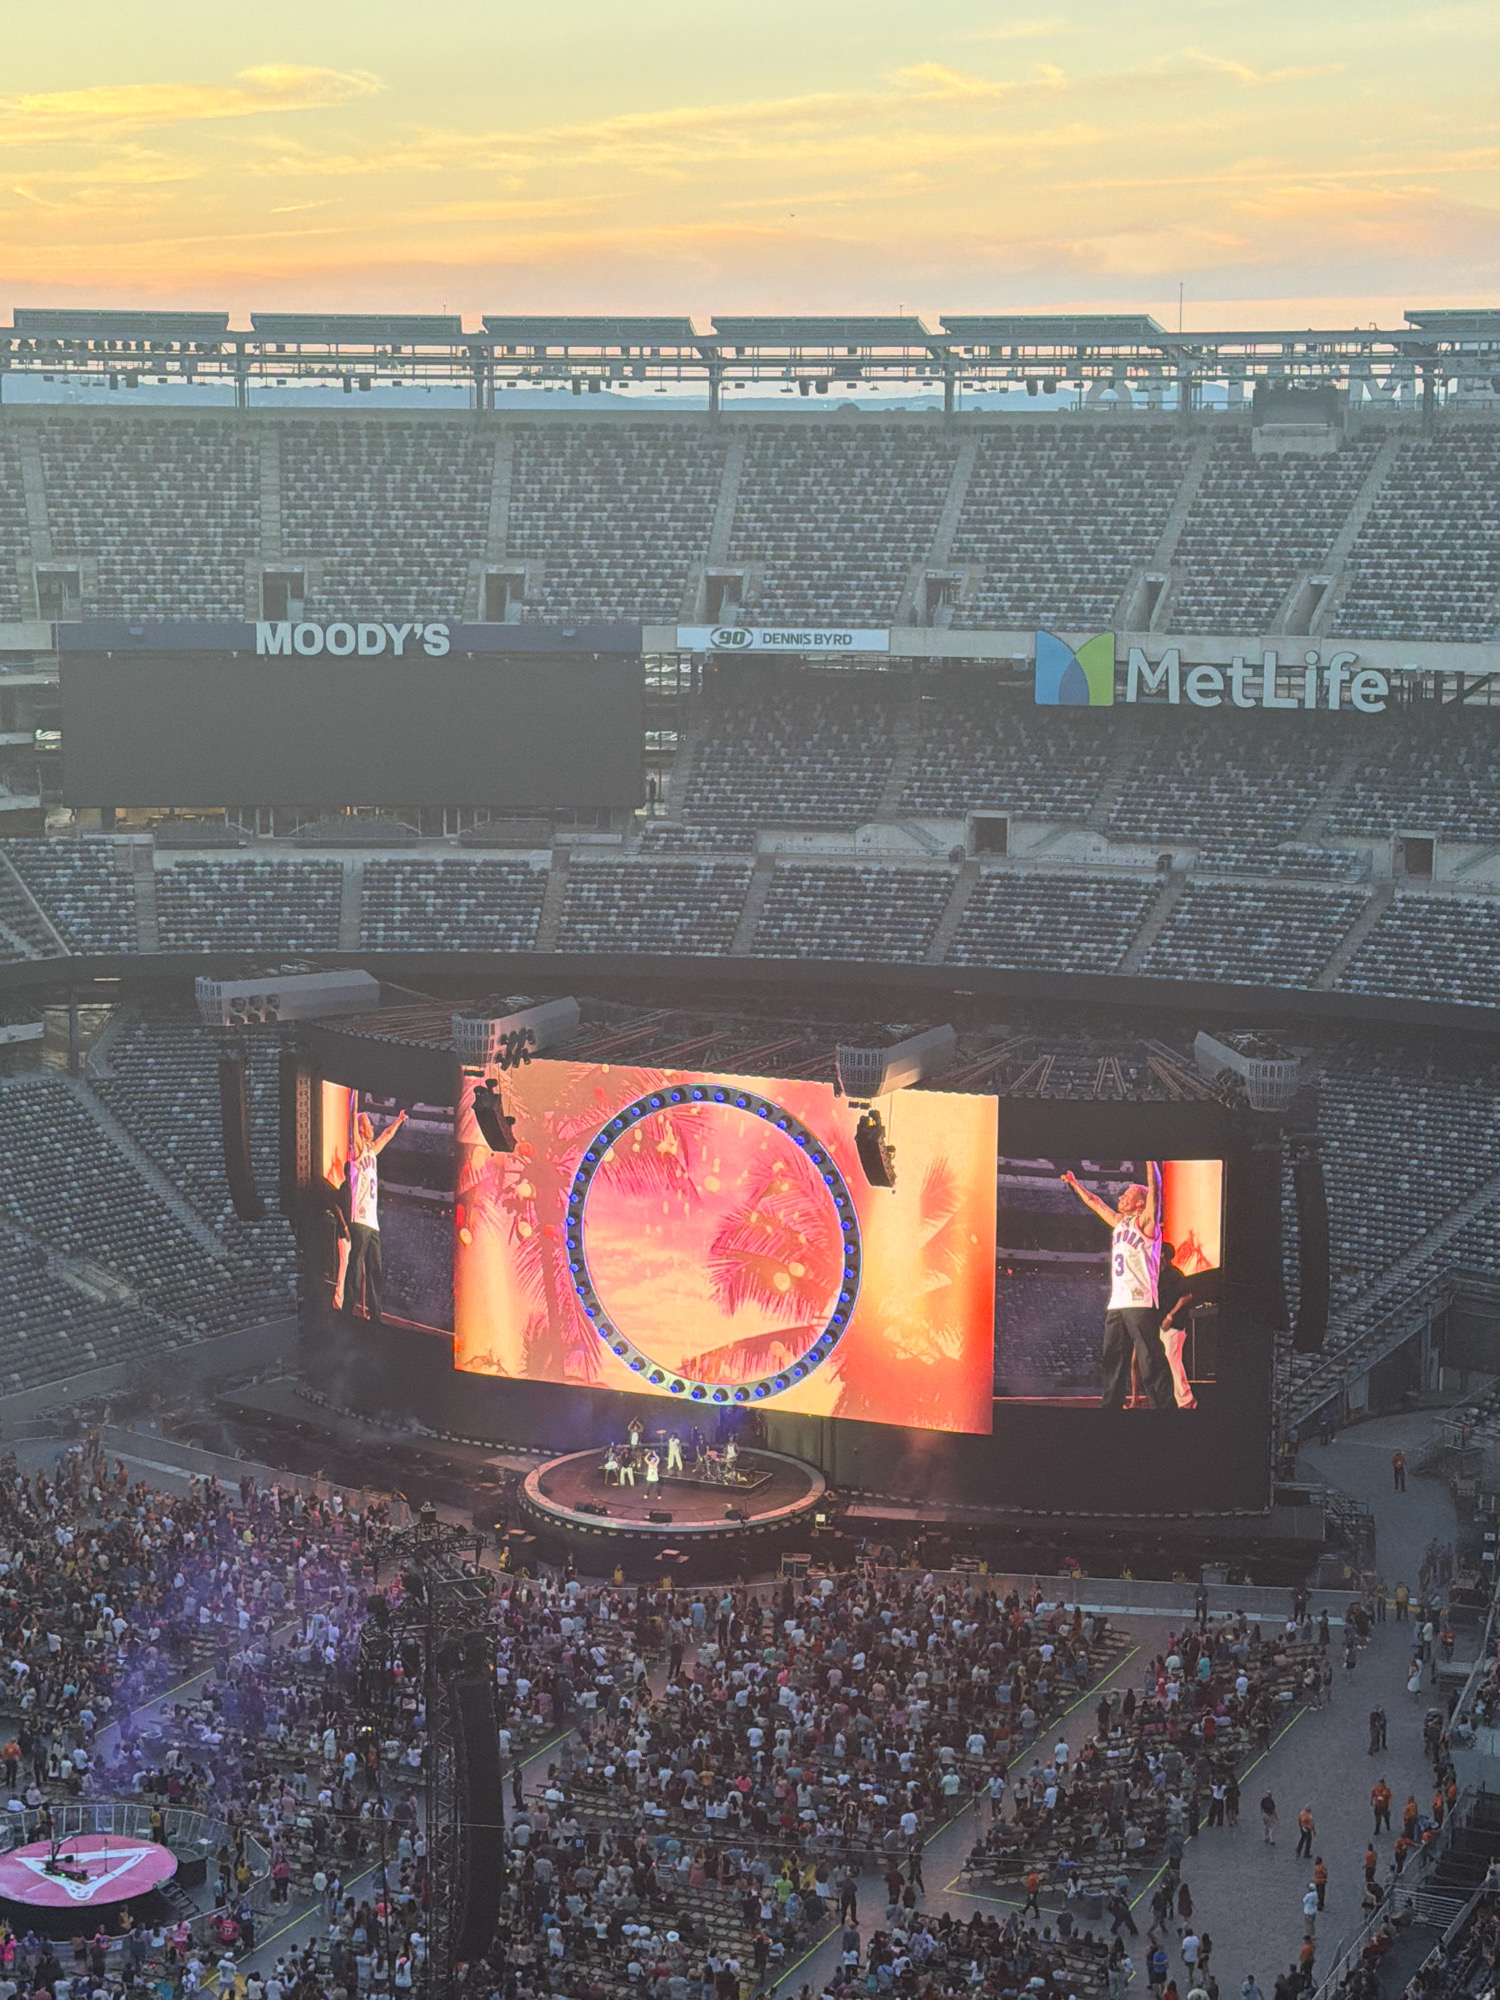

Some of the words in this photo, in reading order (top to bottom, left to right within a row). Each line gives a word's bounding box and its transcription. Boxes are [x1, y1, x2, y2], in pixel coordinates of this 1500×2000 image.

[256, 622, 451, 656] MOODY'S
[718, 631, 746, 645] 90
[762, 633, 811, 645] DENNIS
[814, 634, 852, 645] BYRD
[1126, 647, 1389, 713] MetLife
